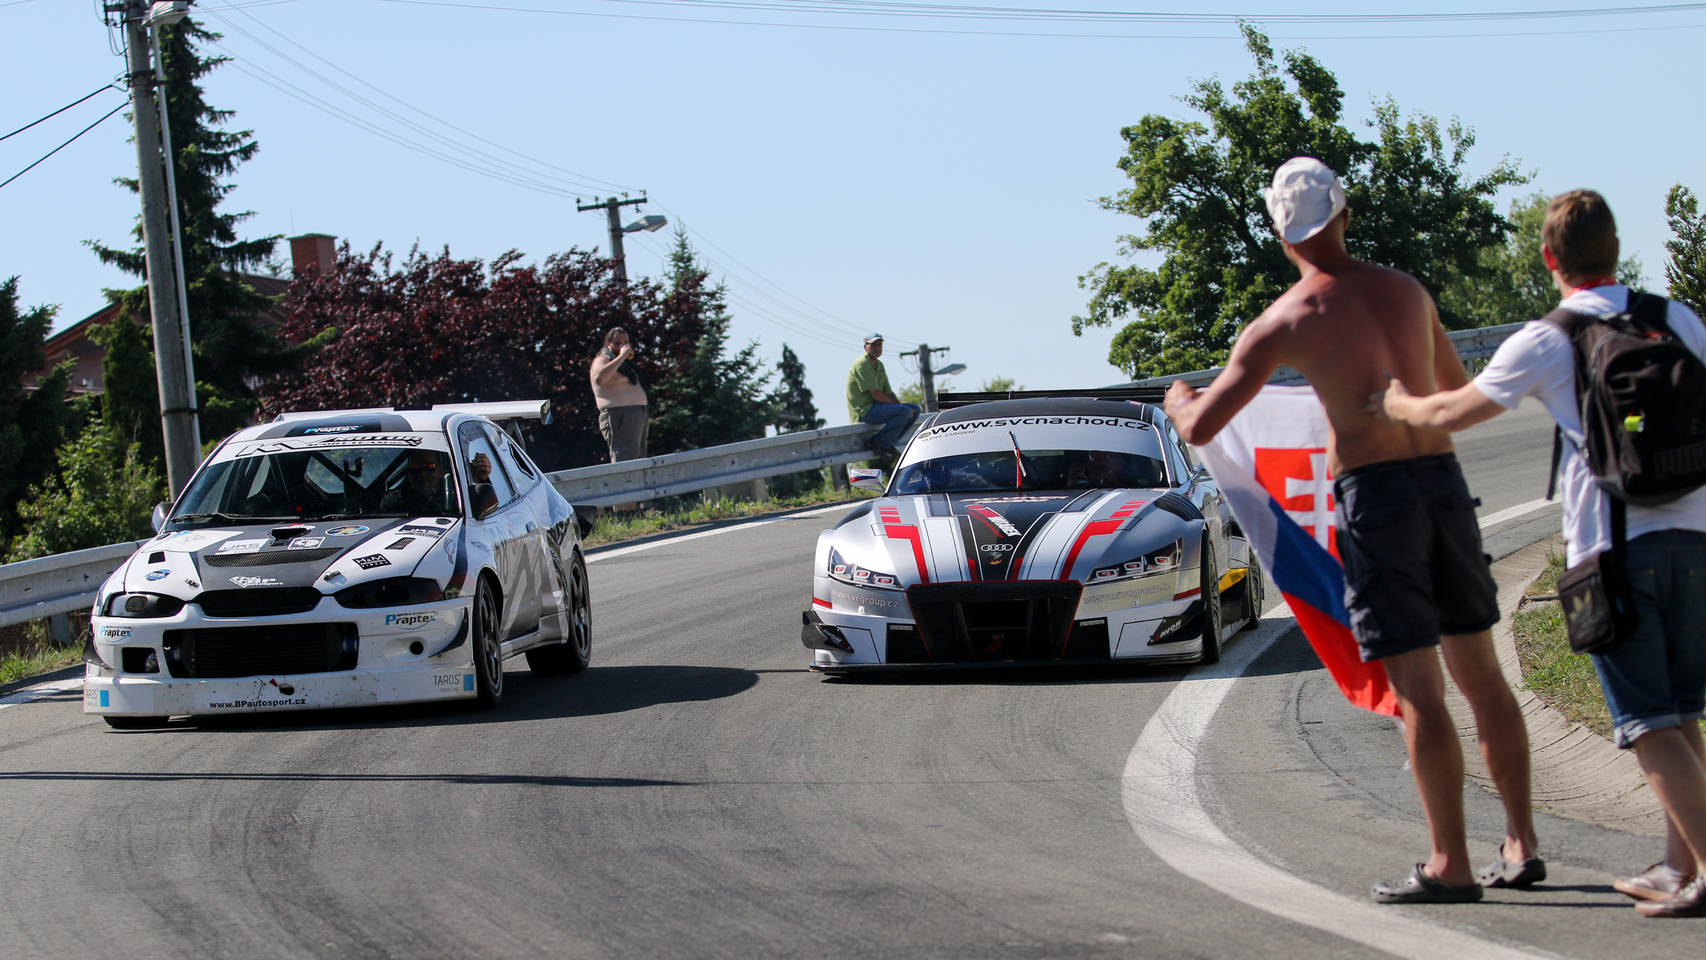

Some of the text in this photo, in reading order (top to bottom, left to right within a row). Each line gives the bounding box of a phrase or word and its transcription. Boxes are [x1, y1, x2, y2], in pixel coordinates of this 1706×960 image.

[931, 416, 1150, 434] www.svcnachod.cz
[831, 589, 899, 608] www.svcgroup.cz
[1083, 582, 1170, 604] www.svcgroup.cz
[385, 612, 438, 627] Praptex
[100, 625, 135, 639] Praptex
[1160, 619, 1182, 638] AVON
[433, 674, 459, 685] TAROS
[209, 698, 306, 708] www.BPautosport.cz
